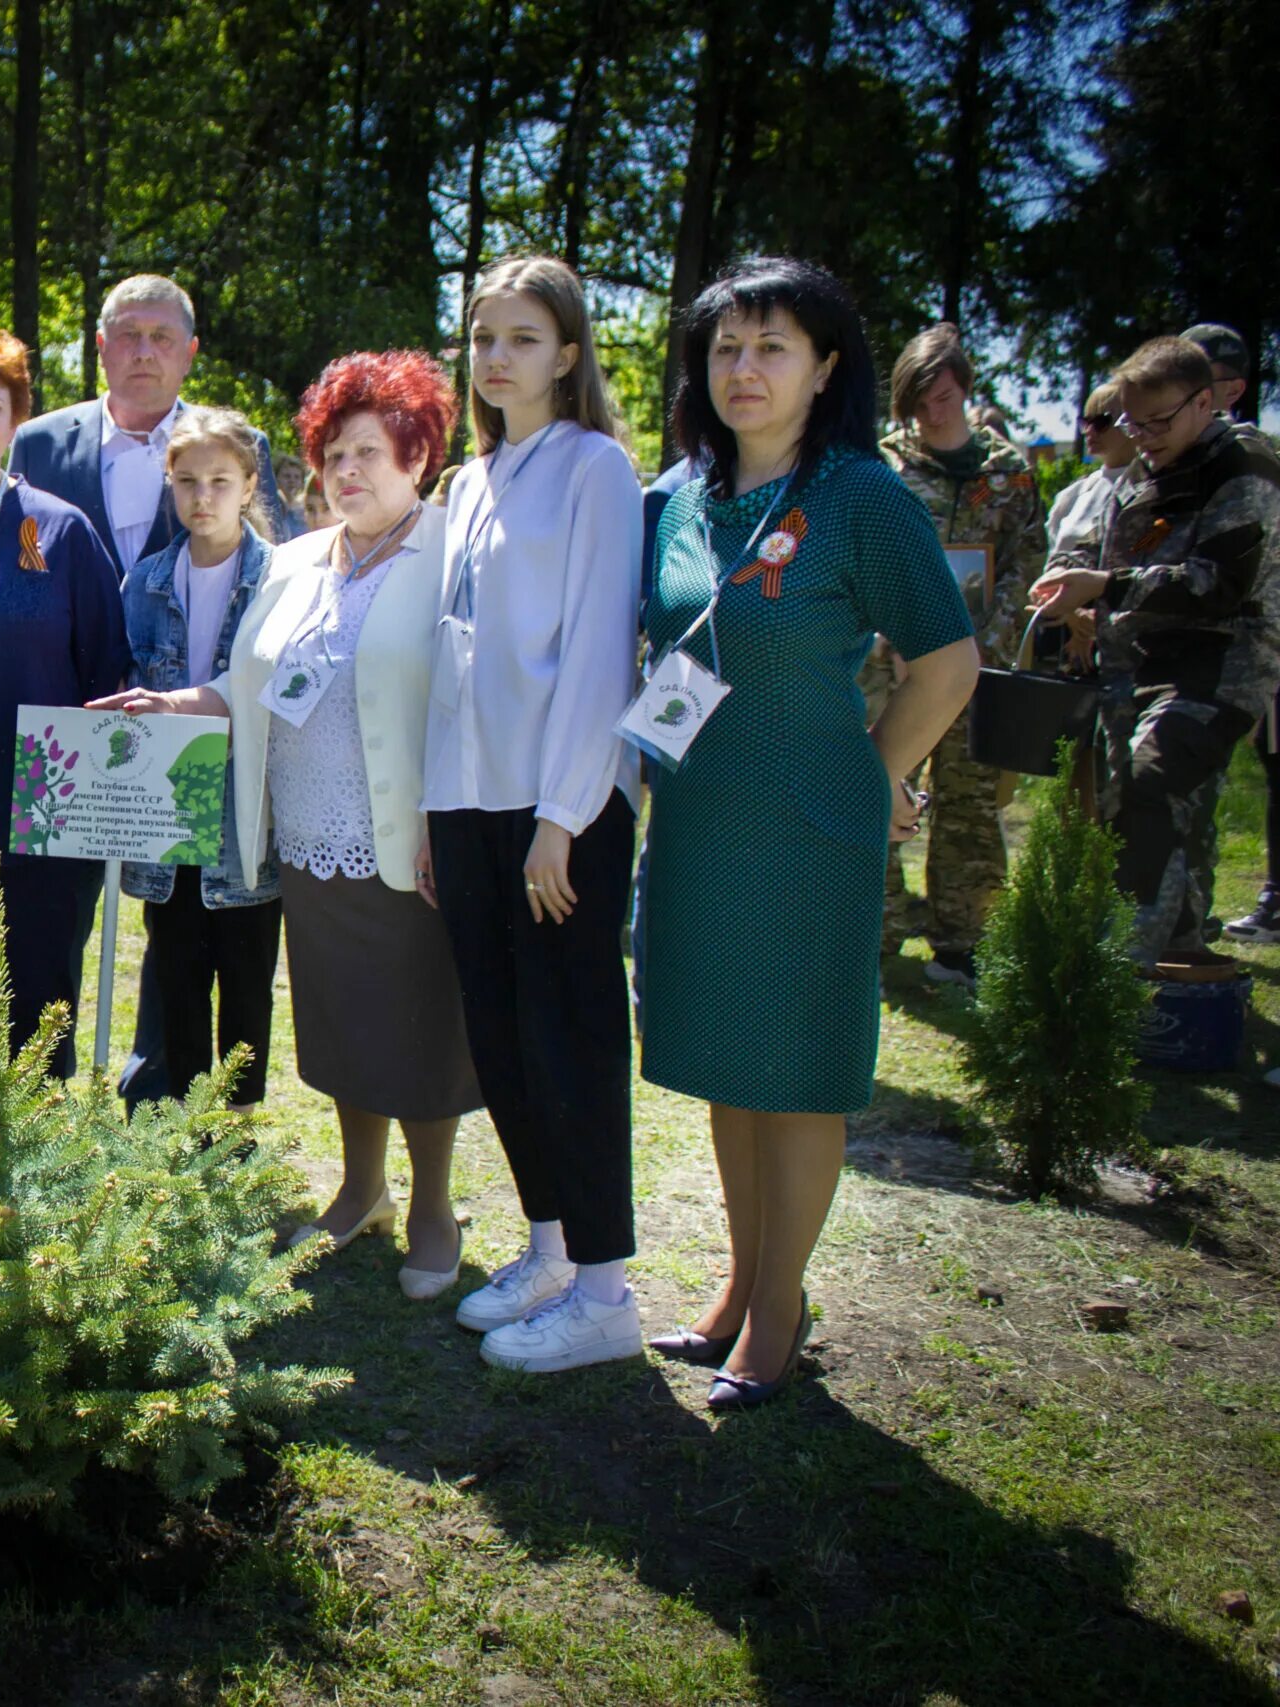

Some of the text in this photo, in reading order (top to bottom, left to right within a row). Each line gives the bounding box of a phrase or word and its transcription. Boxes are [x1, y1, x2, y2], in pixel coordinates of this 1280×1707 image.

[659, 684, 703, 719] САД ПАМЯТИ
[92, 714, 152, 738] САД ПАМЯТИ
[91, 781, 128, 792] Голубая
[74, 792, 163, 804] имени Героя СССР
[86, 802, 142, 814] Семеновича
[94, 816, 136, 826] дочерью,
[95, 826, 121, 836] Героя
[131, 830, 165, 839] рамках
[78, 846, 84, 854] 7
[106, 849, 126, 857] 2021
